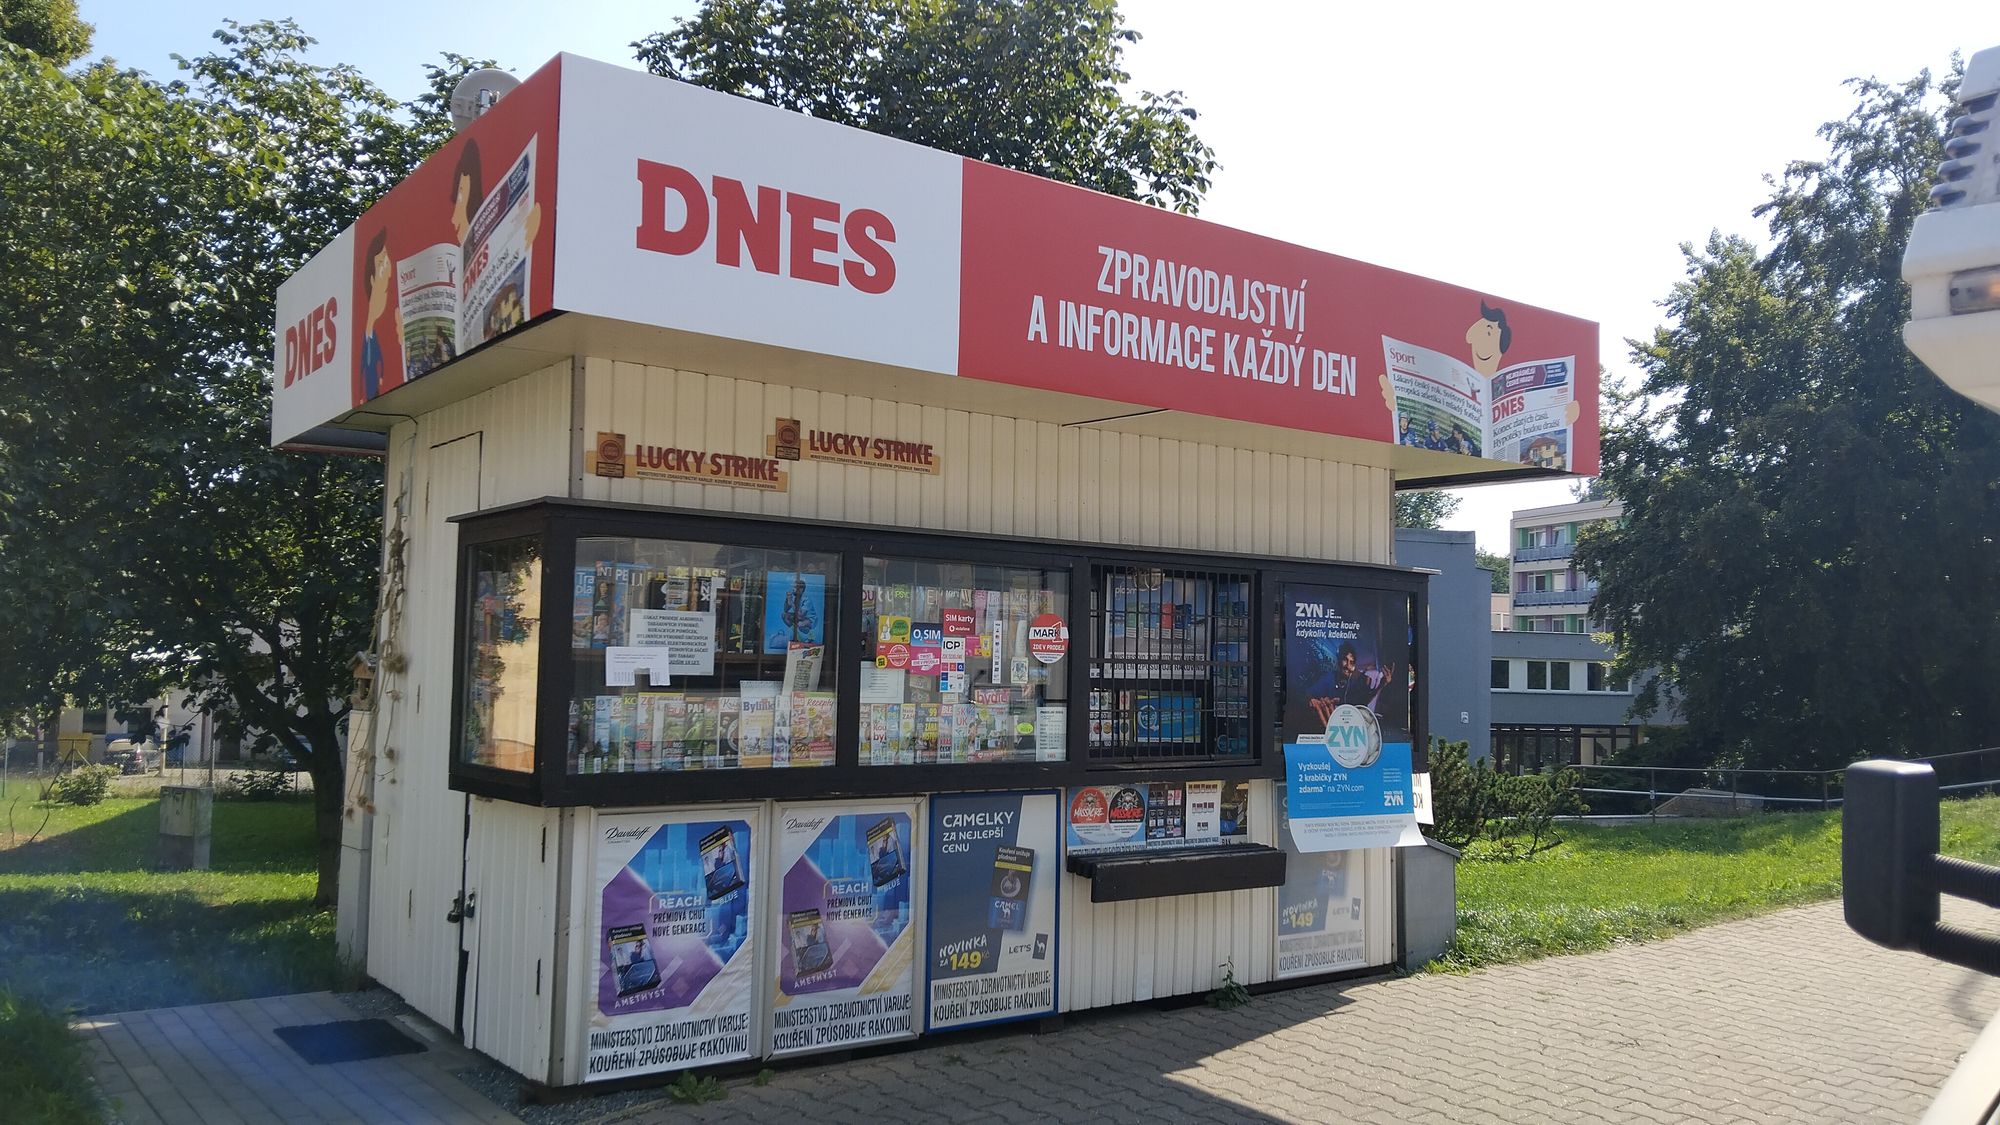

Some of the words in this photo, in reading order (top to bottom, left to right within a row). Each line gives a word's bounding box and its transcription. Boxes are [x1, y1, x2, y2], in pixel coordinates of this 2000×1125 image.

[635, 158, 897, 295] DNES
[1097, 245, 1308, 332] ZPRAVODAJSTVÍ
[284, 297, 338, 390] DNES
[1027, 295, 1048, 344] A
[1058, 299, 1215, 371] INFORMACE
[1223, 328, 1305, 382] KAŽDÝ
[1312, 350, 1357, 397] DEN
[1389, 347, 1416, 365] Sport
[1492, 396, 1525, 423] DNES
[1493, 421, 1512, 437] Konec
[1523, 425, 1541, 435] budou
[809, 429, 870, 457] LUCKY
[873, 438, 933, 466] STRIKE
[636, 444, 705, 473] LUCKY
[710, 453, 779, 482] STRIKE
[1296, 602, 1323, 618] ZYN
[958, 615, 974, 624] karty
[1296, 619, 1327, 628] potěšení
[1327, 620, 1339, 628] bez
[1341, 621, 1360, 630] kouře
[924, 629, 941, 640] SIM
[1296, 629, 1327, 638] kdykoliv,
[1328, 630, 1357, 639] kdekoliv.
[943, 641, 960, 649] ICP
[1327, 725, 1367, 748] ZYN
[1298, 762, 1331, 772] Vyzkoušej
[1298, 774, 1303, 782] 2
[1304, 773, 1332, 783] krabičky
[1333, 773, 1347, 781] ZYN
[1327, 785, 1335, 793] na
[1336, 784, 1364, 793] ZYN.com
[1384, 794, 1404, 806] ZYN
[786, 817, 825, 830] Davidoff
[942, 811, 1014, 828] CAMELKY
[605, 825, 652, 840] Davidoff
[943, 832, 956, 841] ZA
[959, 826, 1004, 840] NEJLEPŠÍ
[942, 843, 970, 853] CENU
[831, 882, 868, 895] REACH
[659, 896, 701, 909] REACH
[827, 896, 856, 908] PRÉMIOVÁ
[994, 901, 1019, 910] CAMEL
[1282, 898, 1319, 918] NOVINKA
[653, 909, 687, 923] PRÉMIOVÁ
[826, 909, 841, 920] NOVÉ
[843, 907, 873, 920] GENERACE
[1289, 912, 1314, 929] 149
[652, 924, 671, 937] NOVÉ
[672, 922, 706, 936] GENERACE
[939, 934, 988, 958] NOVINKA
[1008, 944, 1031, 954] LET'S
[939, 958, 948, 967] ZA
[949, 951, 982, 971] 149
[1278, 951, 1304, 971] KOUŘENÍ
[1304, 947, 1336, 967] ZPŮSOBUJE
[1336, 944, 1364, 963] RAKOVINU
[794, 969, 837, 988] AMETHYST
[934, 980, 980, 1001] MINISTERSTVO
[981, 970, 1026, 995] ZDRAVOTNICTVÍ
[1027, 970, 1050, 988] VARUJE:
[614, 988, 666, 1009] AMETHYST
[934, 1000, 967, 1023] KOUŘENÍ
[969, 996, 1012, 1016] ZPŮSOBUJE
[1014, 988, 1051, 1008] RAKOVINU
[774, 1005, 827, 1029] MINISTERSTVO
[829, 995, 882, 1023] ZDRAVOTNICTVÍ
[883, 994, 911, 1012] VARUJE:
[590, 1026, 652, 1050] MINISTERSTVO
[655, 1014, 717, 1043] ZDRAVOTNICTVÍ
[717, 1013, 748, 1032] VARUJE:
[773, 1025, 813, 1050] KOUŘENÍ
[815, 1022, 866, 1044] ZPŮSOBUJE
[868, 1015, 911, 1037] RAKOVINU
[589, 1049, 635, 1074] KOUŘENÍ
[638, 1043, 697, 1067] ZPŮSOBUJE
[699, 1034, 748, 1058] RAKOVINU
